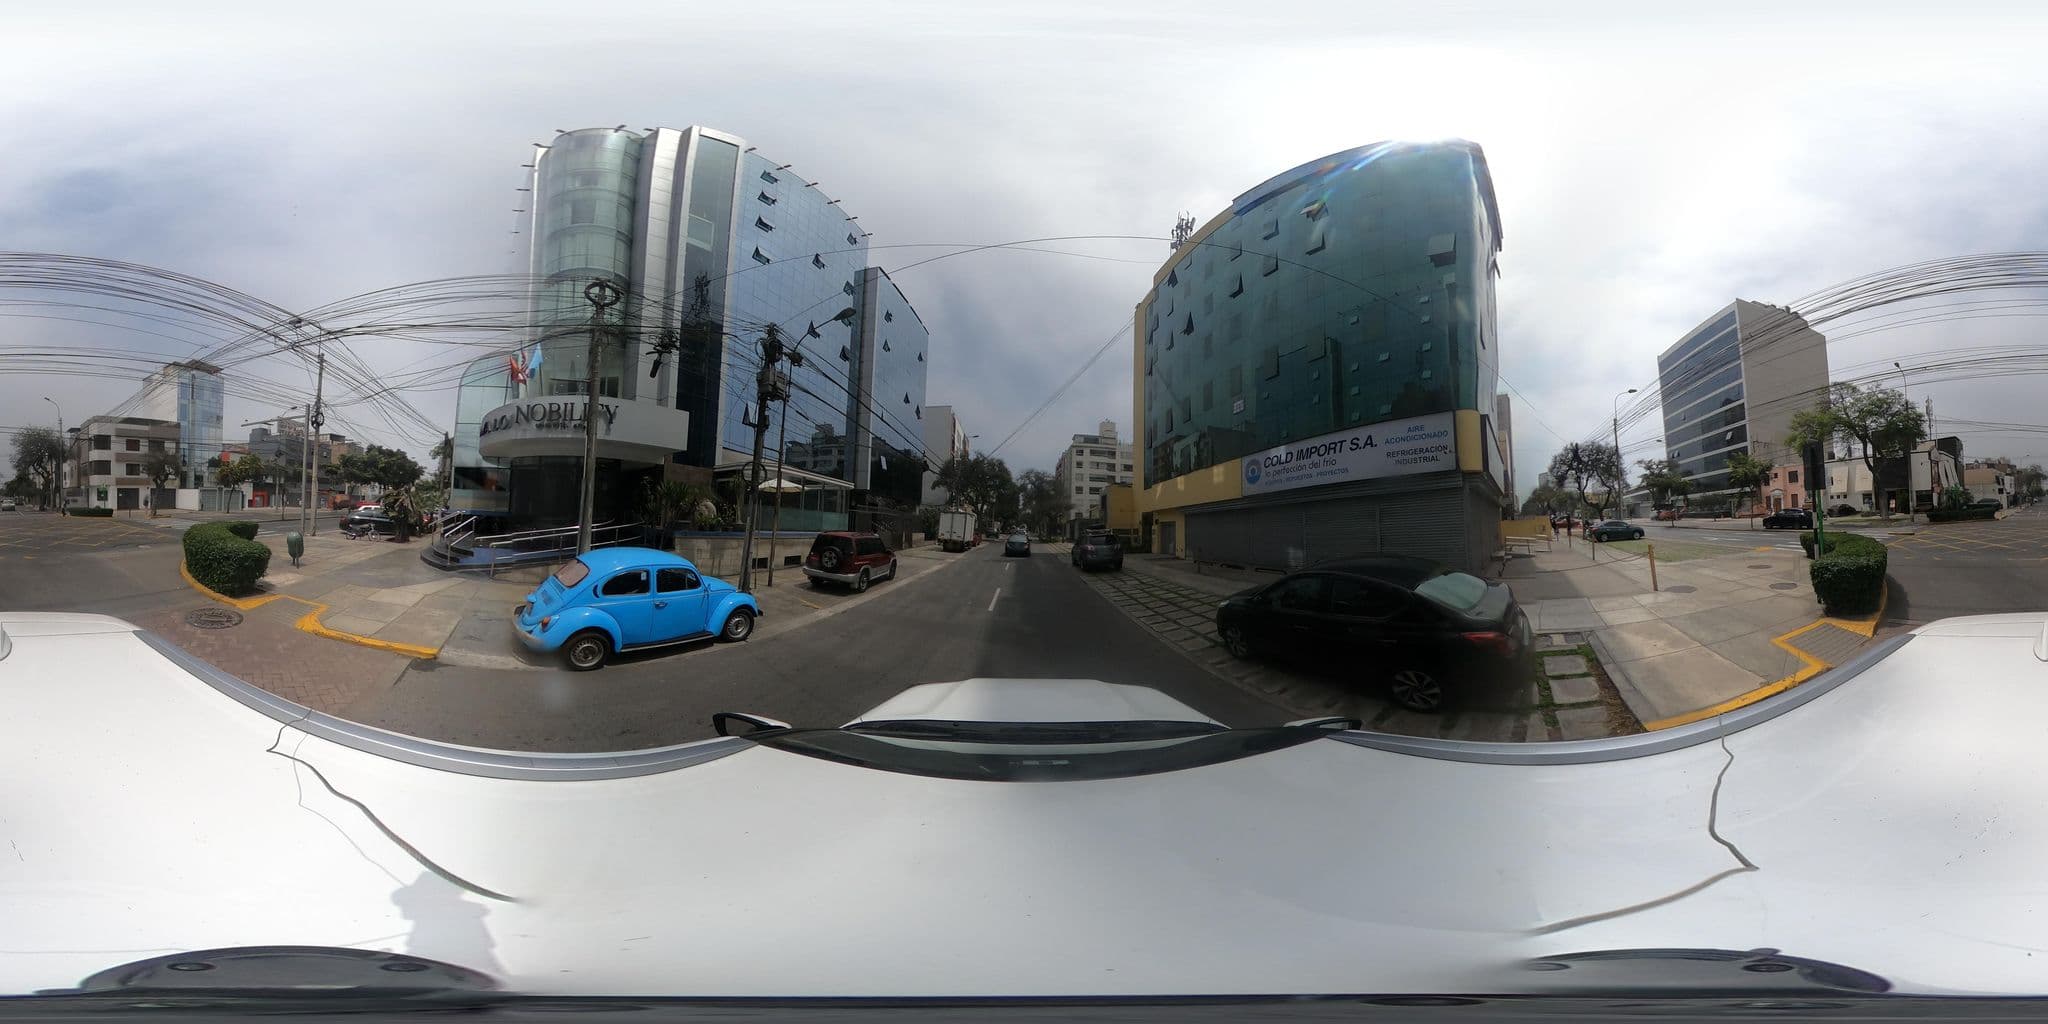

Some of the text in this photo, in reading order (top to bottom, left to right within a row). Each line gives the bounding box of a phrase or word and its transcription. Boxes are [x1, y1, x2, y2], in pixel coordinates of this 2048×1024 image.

[1407, 424, 1425, 433] AIRE
[1385, 430, 1448, 445] ACONDICIONADO
[1264, 434, 1378, 468] COLD IMPORT S.A.
[1394, 455, 1440, 465] INDUSTRIAL
[1272, 463, 1307, 479] perfección
[1308, 459, 1321, 470] del
